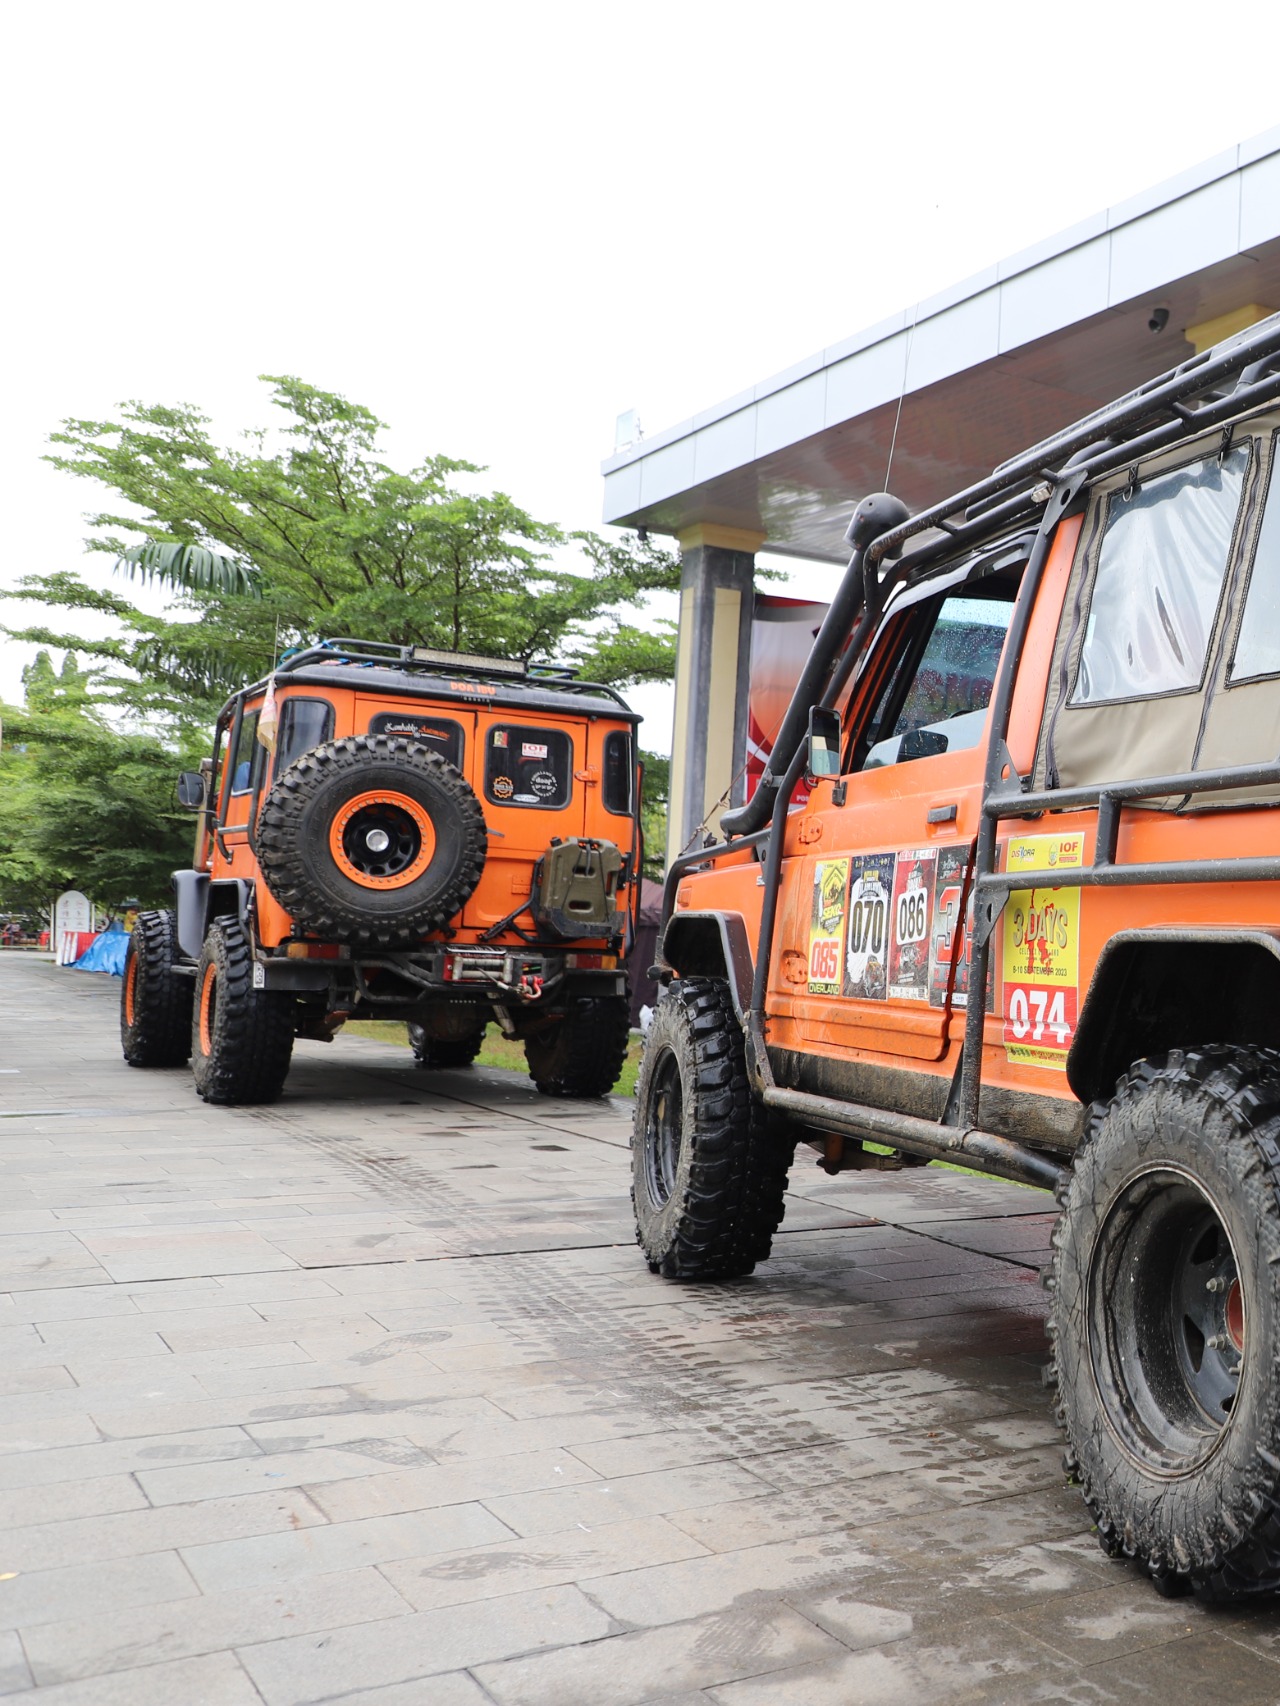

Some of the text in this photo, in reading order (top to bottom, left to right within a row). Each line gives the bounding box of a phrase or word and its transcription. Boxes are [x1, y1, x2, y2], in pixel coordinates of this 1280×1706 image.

[450, 682, 496, 696] DOA IBU
[523, 744, 546, 752] IOF
[1060, 842, 1078, 853] IOF
[851, 900, 884, 954] 070
[900, 892, 925, 941] 086
[1014, 908, 1068, 949] 3 DAYS
[811, 941, 839, 979] 085
[1055, 967, 1067, 977] 2023
[808, 983, 840, 995] OVERLAND
[1010, 988, 1071, 1044] 074
